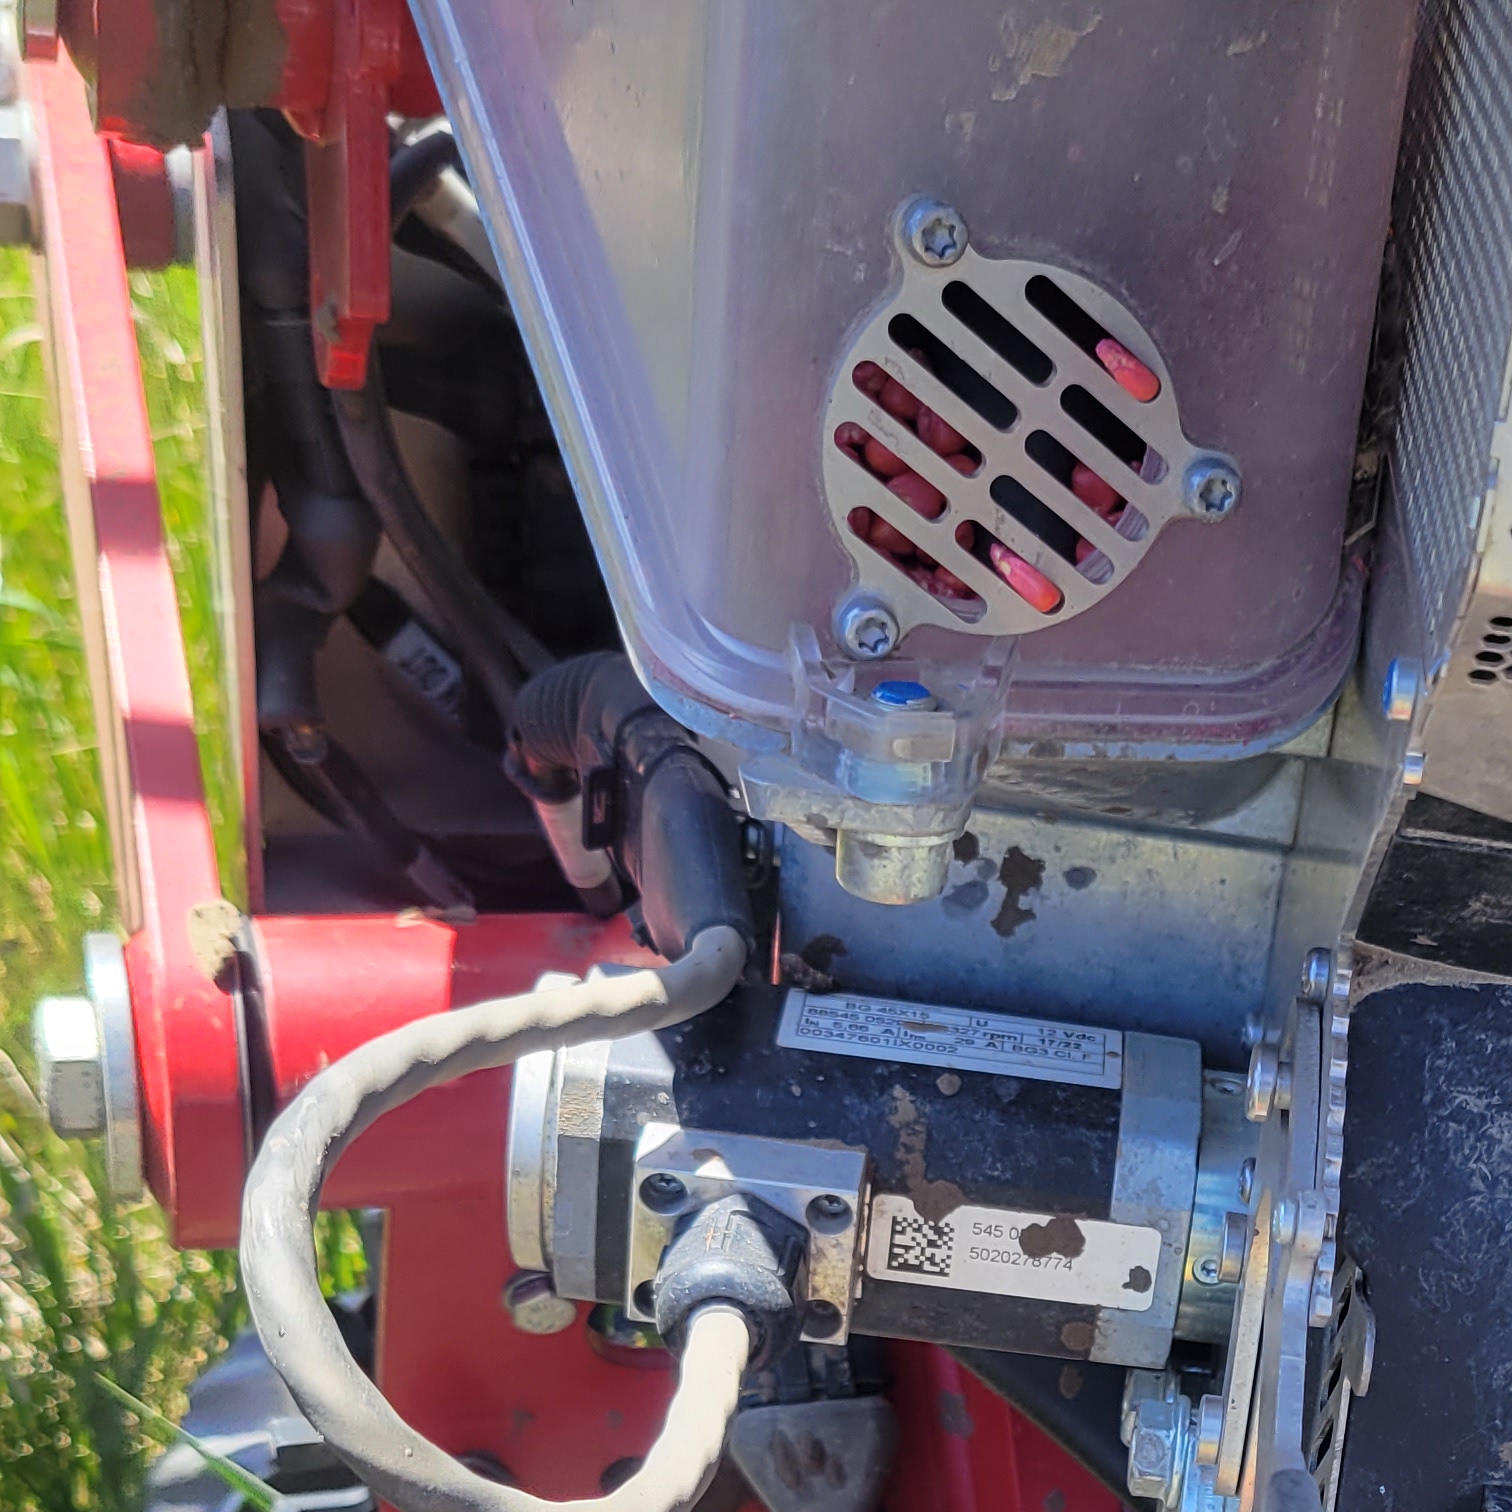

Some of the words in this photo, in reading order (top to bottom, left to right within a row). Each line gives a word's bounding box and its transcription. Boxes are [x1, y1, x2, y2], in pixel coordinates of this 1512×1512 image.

[846, 1002, 872, 1012] BG
[881, 1028, 895, 1036] A
[976, 1019, 988, 1027] U
[1038, 1028, 1056, 1036] 12
[1063, 1031, 1096, 1042] Vdc
[982, 1031, 1018, 1043] rpm
[985, 1041, 998, 1049] A
[1039, 1038, 1082, 1050] 17/22
[971, 1222, 1004, 1239] 545
